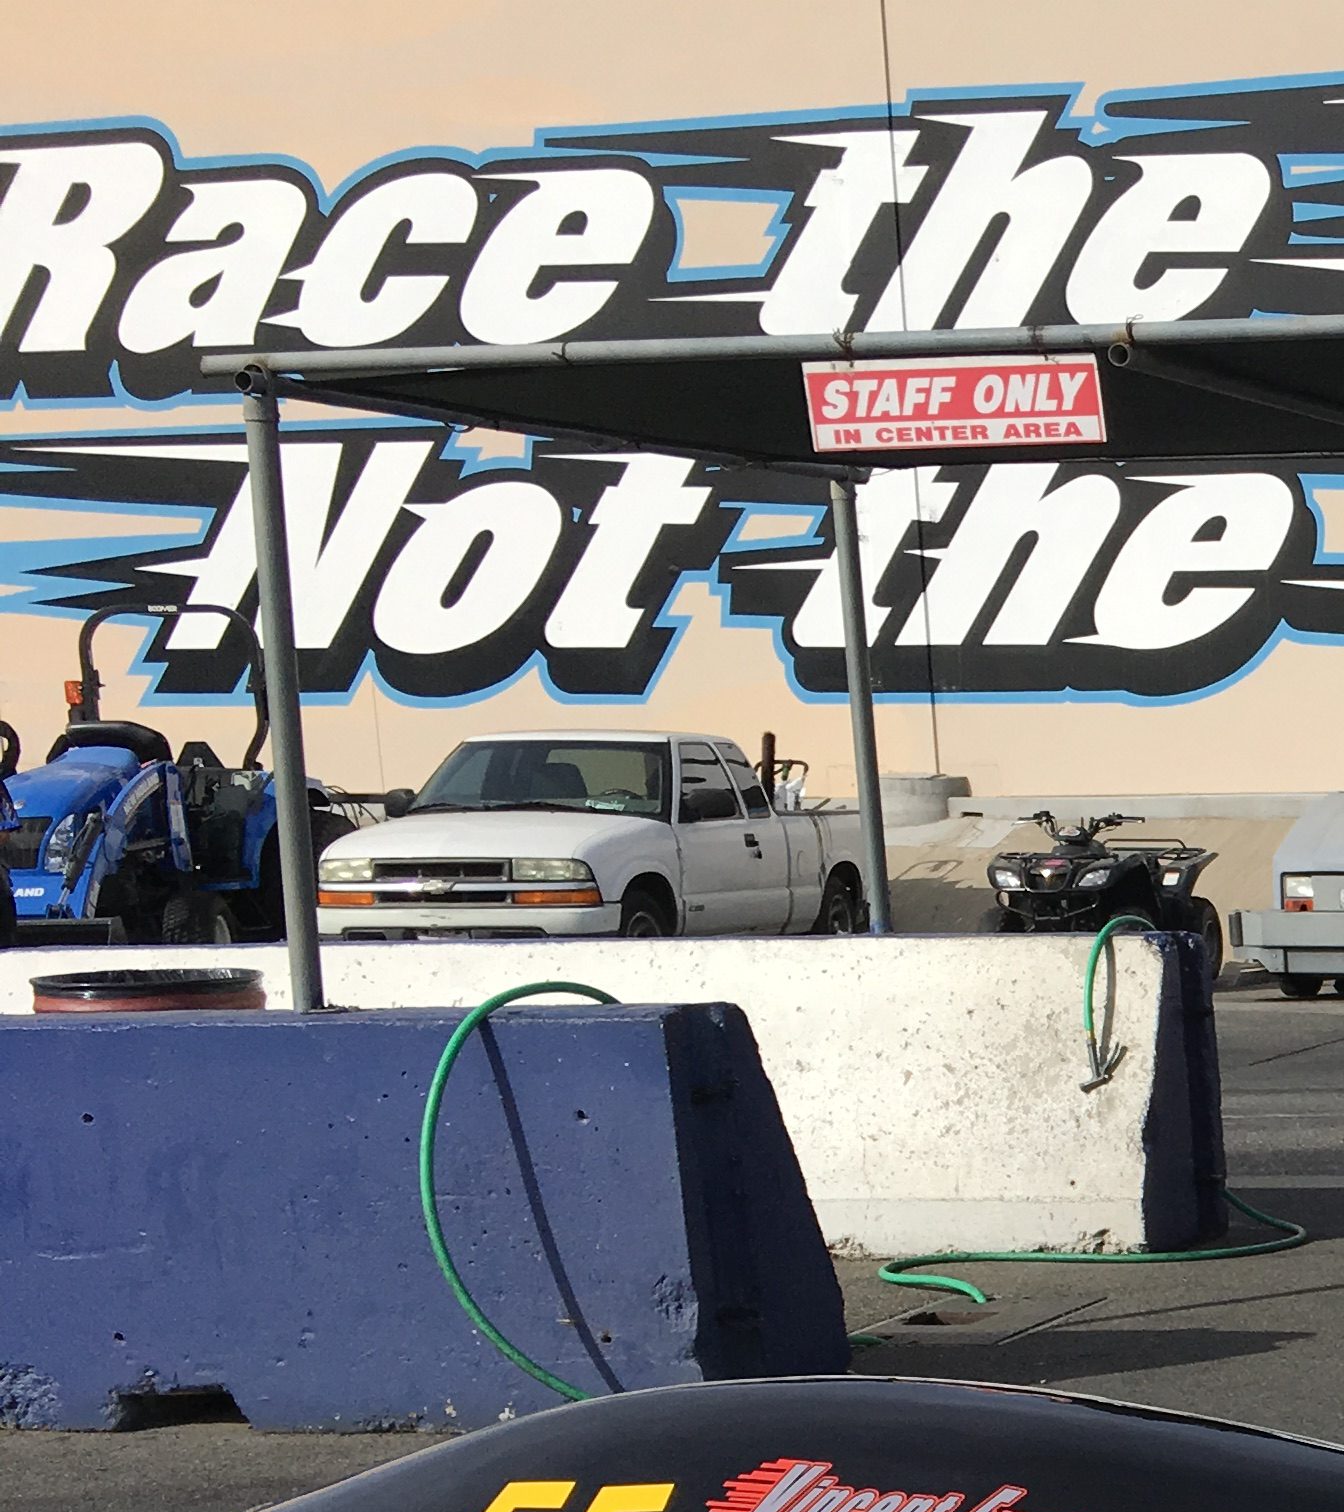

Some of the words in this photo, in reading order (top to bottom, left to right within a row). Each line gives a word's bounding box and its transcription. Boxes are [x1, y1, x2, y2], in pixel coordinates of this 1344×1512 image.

[0, 134, 655, 353] Race
[758, 110, 1274, 337] the
[821, 376, 956, 420] STAFF
[973, 371, 1088, 415] ONLY
[833, 428, 862, 445] IN
[875, 425, 989, 443] CENTER
[1003, 421, 1083, 439] AREA
[140, 440, 718, 655] Not
[790, 464, 1299, 648] the
